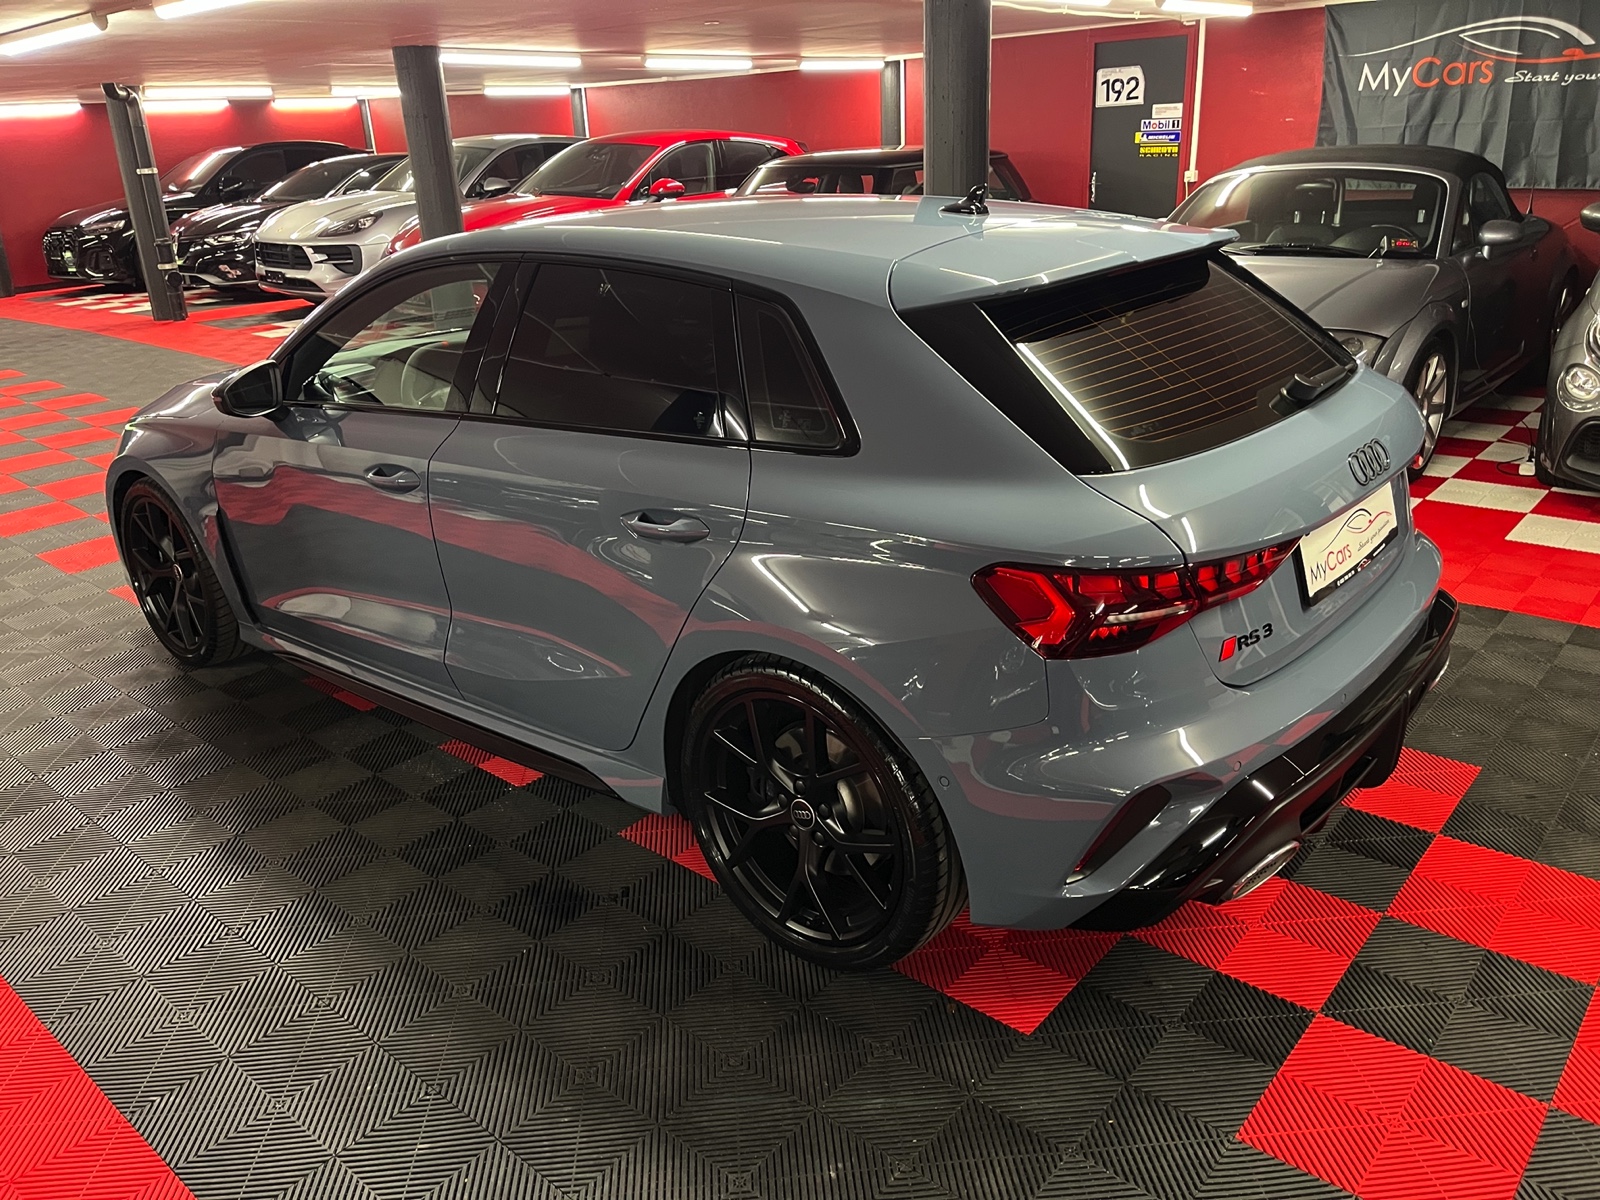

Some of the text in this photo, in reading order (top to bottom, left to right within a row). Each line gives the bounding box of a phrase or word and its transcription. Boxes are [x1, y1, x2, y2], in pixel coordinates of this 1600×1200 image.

[1101, 76, 1140, 102] 192
[1358, 56, 1494, 97] MyCars
[1504, 70, 1559, 84] Start
[1142, 120, 1170, 129] Mobil
[1310, 544, 1352, 585] MyCars
[1237, 622, 1274, 651] RS 3
